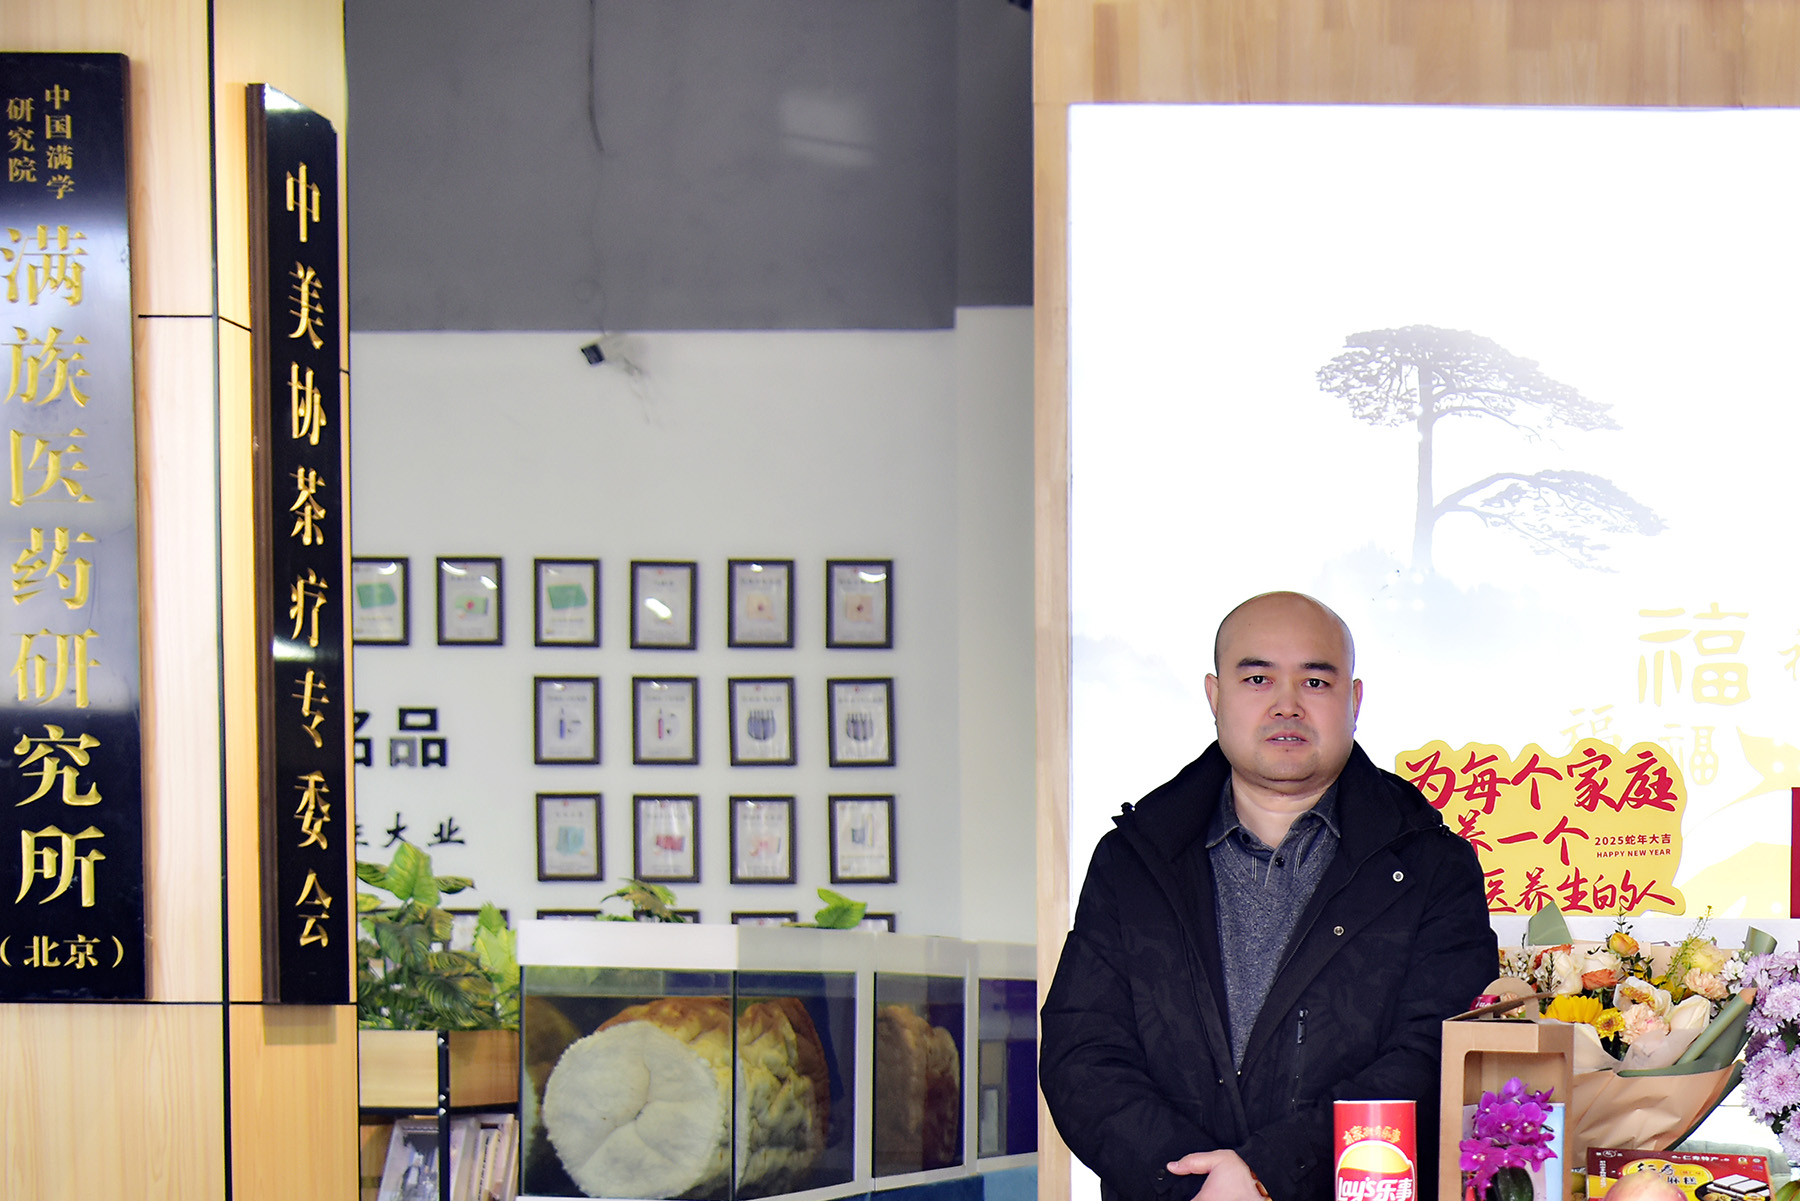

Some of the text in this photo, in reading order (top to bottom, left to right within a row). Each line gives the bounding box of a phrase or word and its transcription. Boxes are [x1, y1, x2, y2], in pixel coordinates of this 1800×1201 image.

[6, 96, 38, 184] 研究院
[44, 84, 75, 201] 中国满学
[0, 222, 107, 910] 满族医药研究所
[284, 161, 334, 951] 中美协茶疗专委会
[1405, 747, 1679, 815] 为每个家庭
[1594, 833, 1673, 847] 2025蛇年大吉
[1596, 848, 1672, 859] HAPPY NEW YEAR
